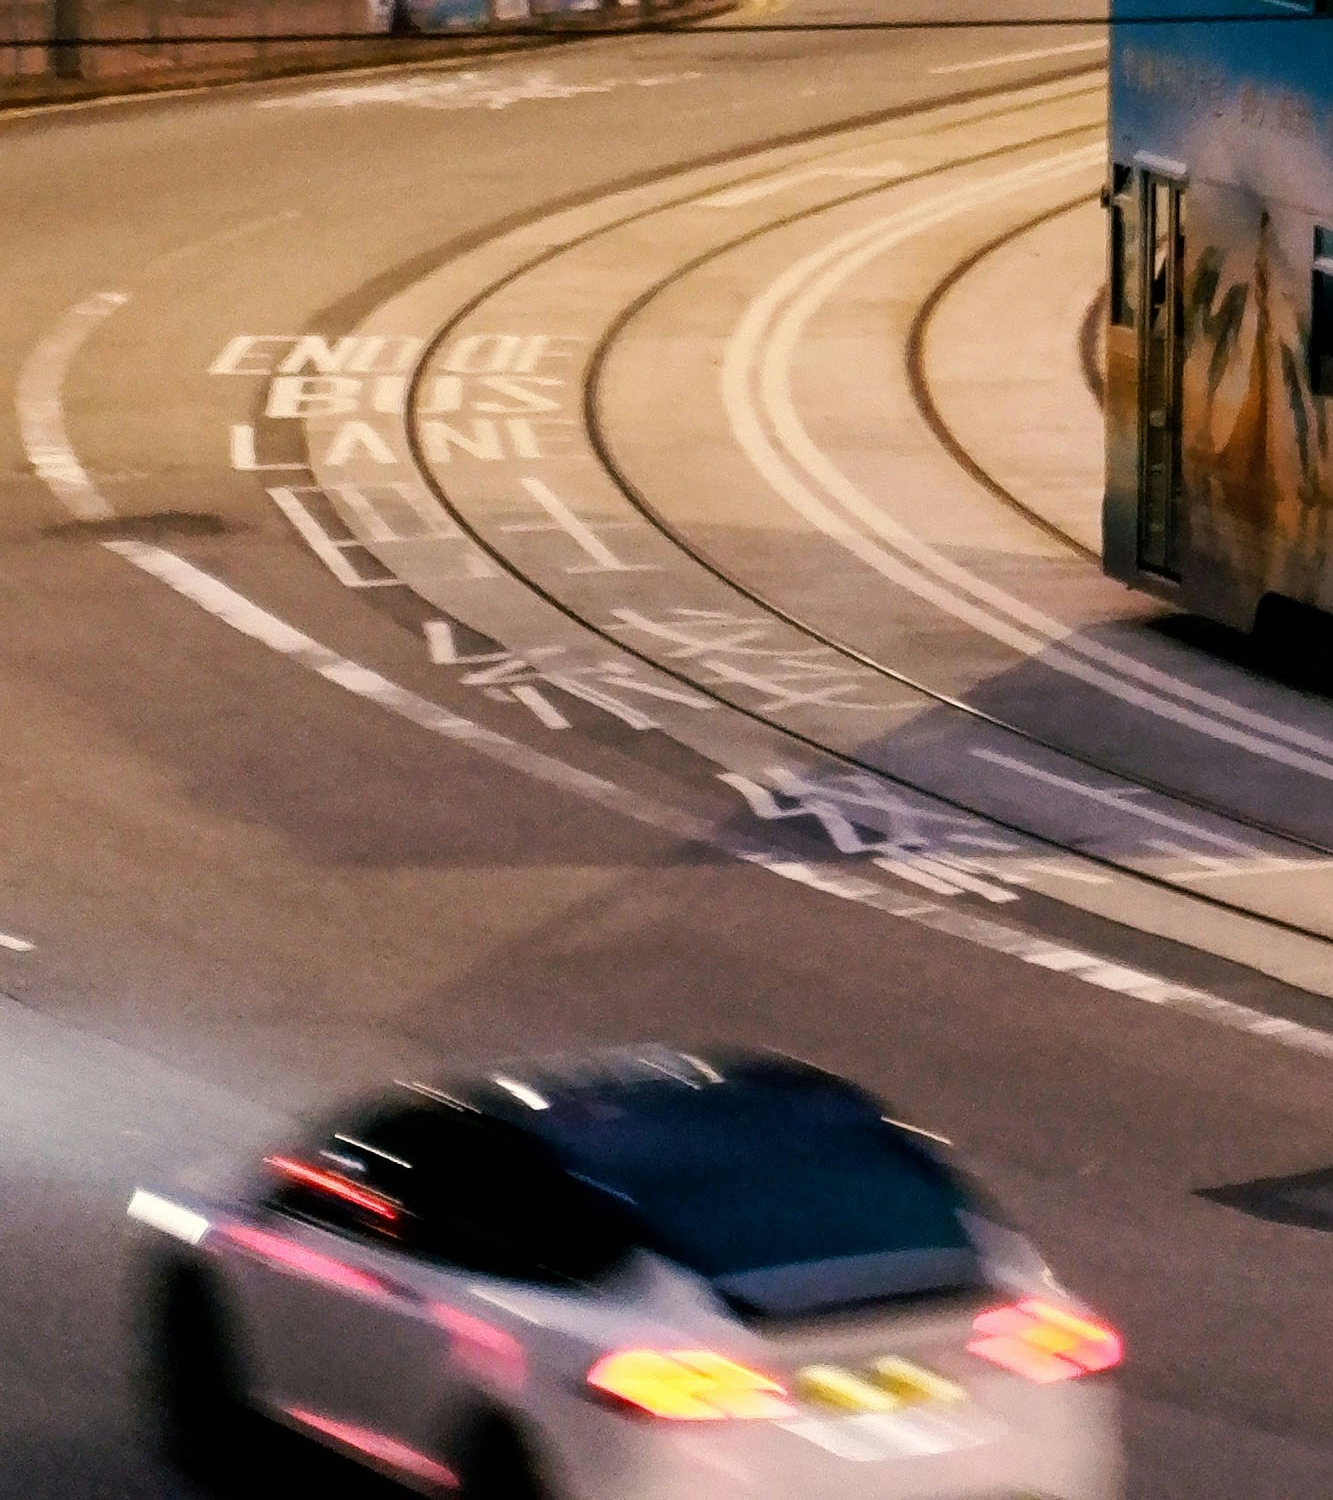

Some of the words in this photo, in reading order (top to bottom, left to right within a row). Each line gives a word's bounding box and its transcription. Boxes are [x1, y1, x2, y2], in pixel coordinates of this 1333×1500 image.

[207, 334, 424, 375] END
[440, 333, 595, 374] OF
[264, 375, 568, 419] BUS
[229, 418, 596, 470] LANE
